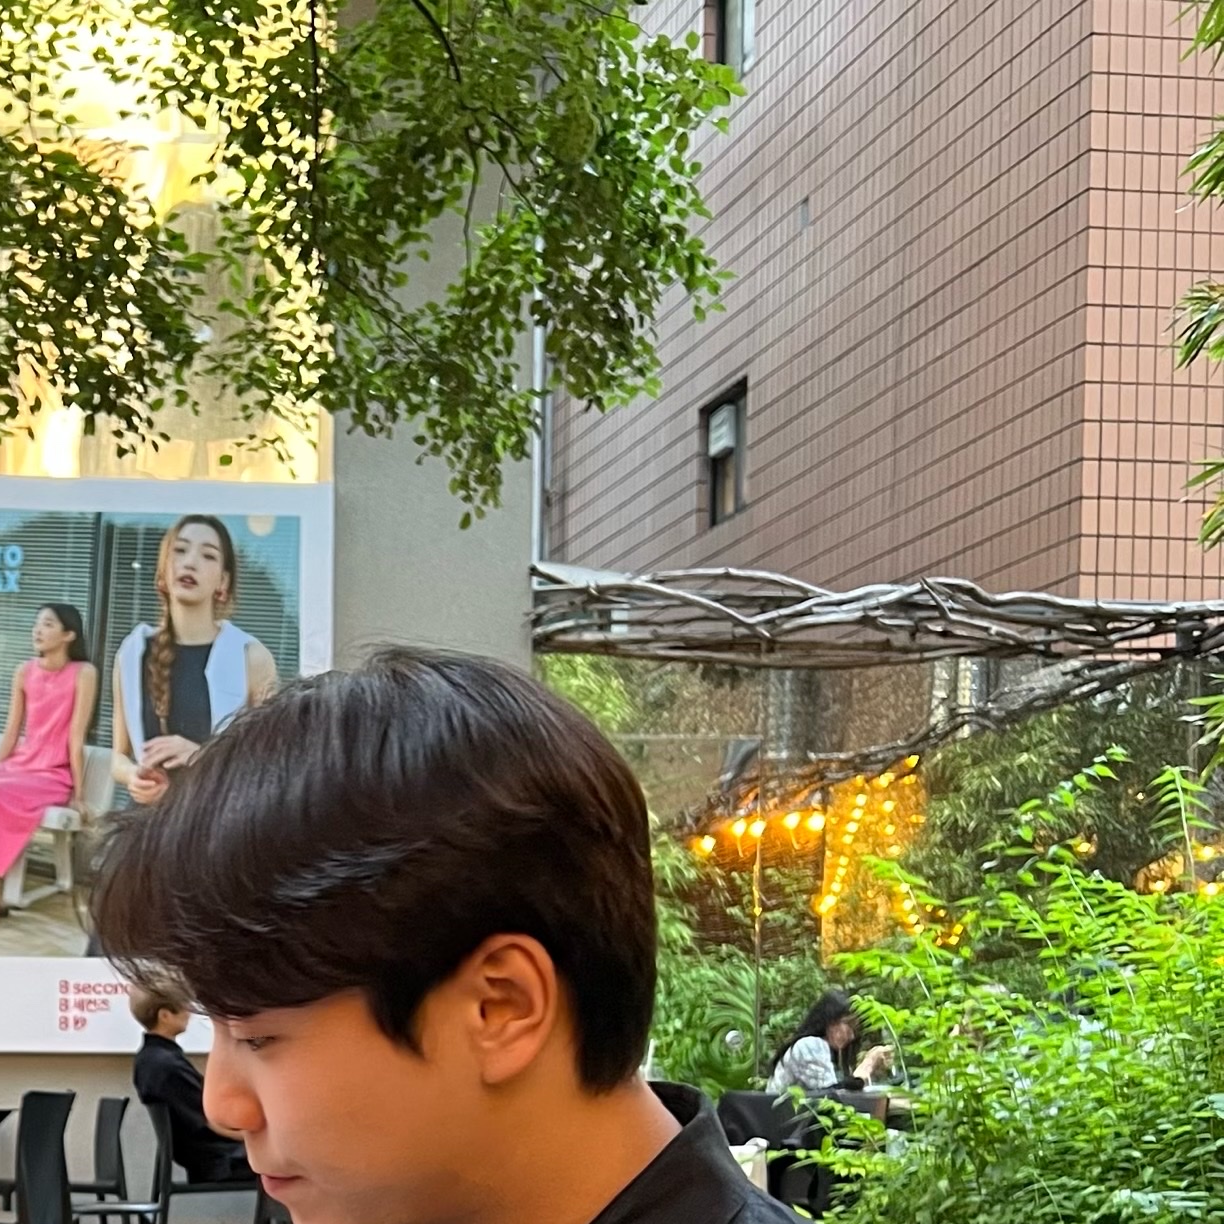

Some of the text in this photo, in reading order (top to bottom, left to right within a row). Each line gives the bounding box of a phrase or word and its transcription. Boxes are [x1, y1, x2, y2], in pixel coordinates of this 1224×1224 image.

[58, 979, 70, 995] 8
[58, 997, 70, 1013] 8
[58, 1015, 70, 1031] 8
